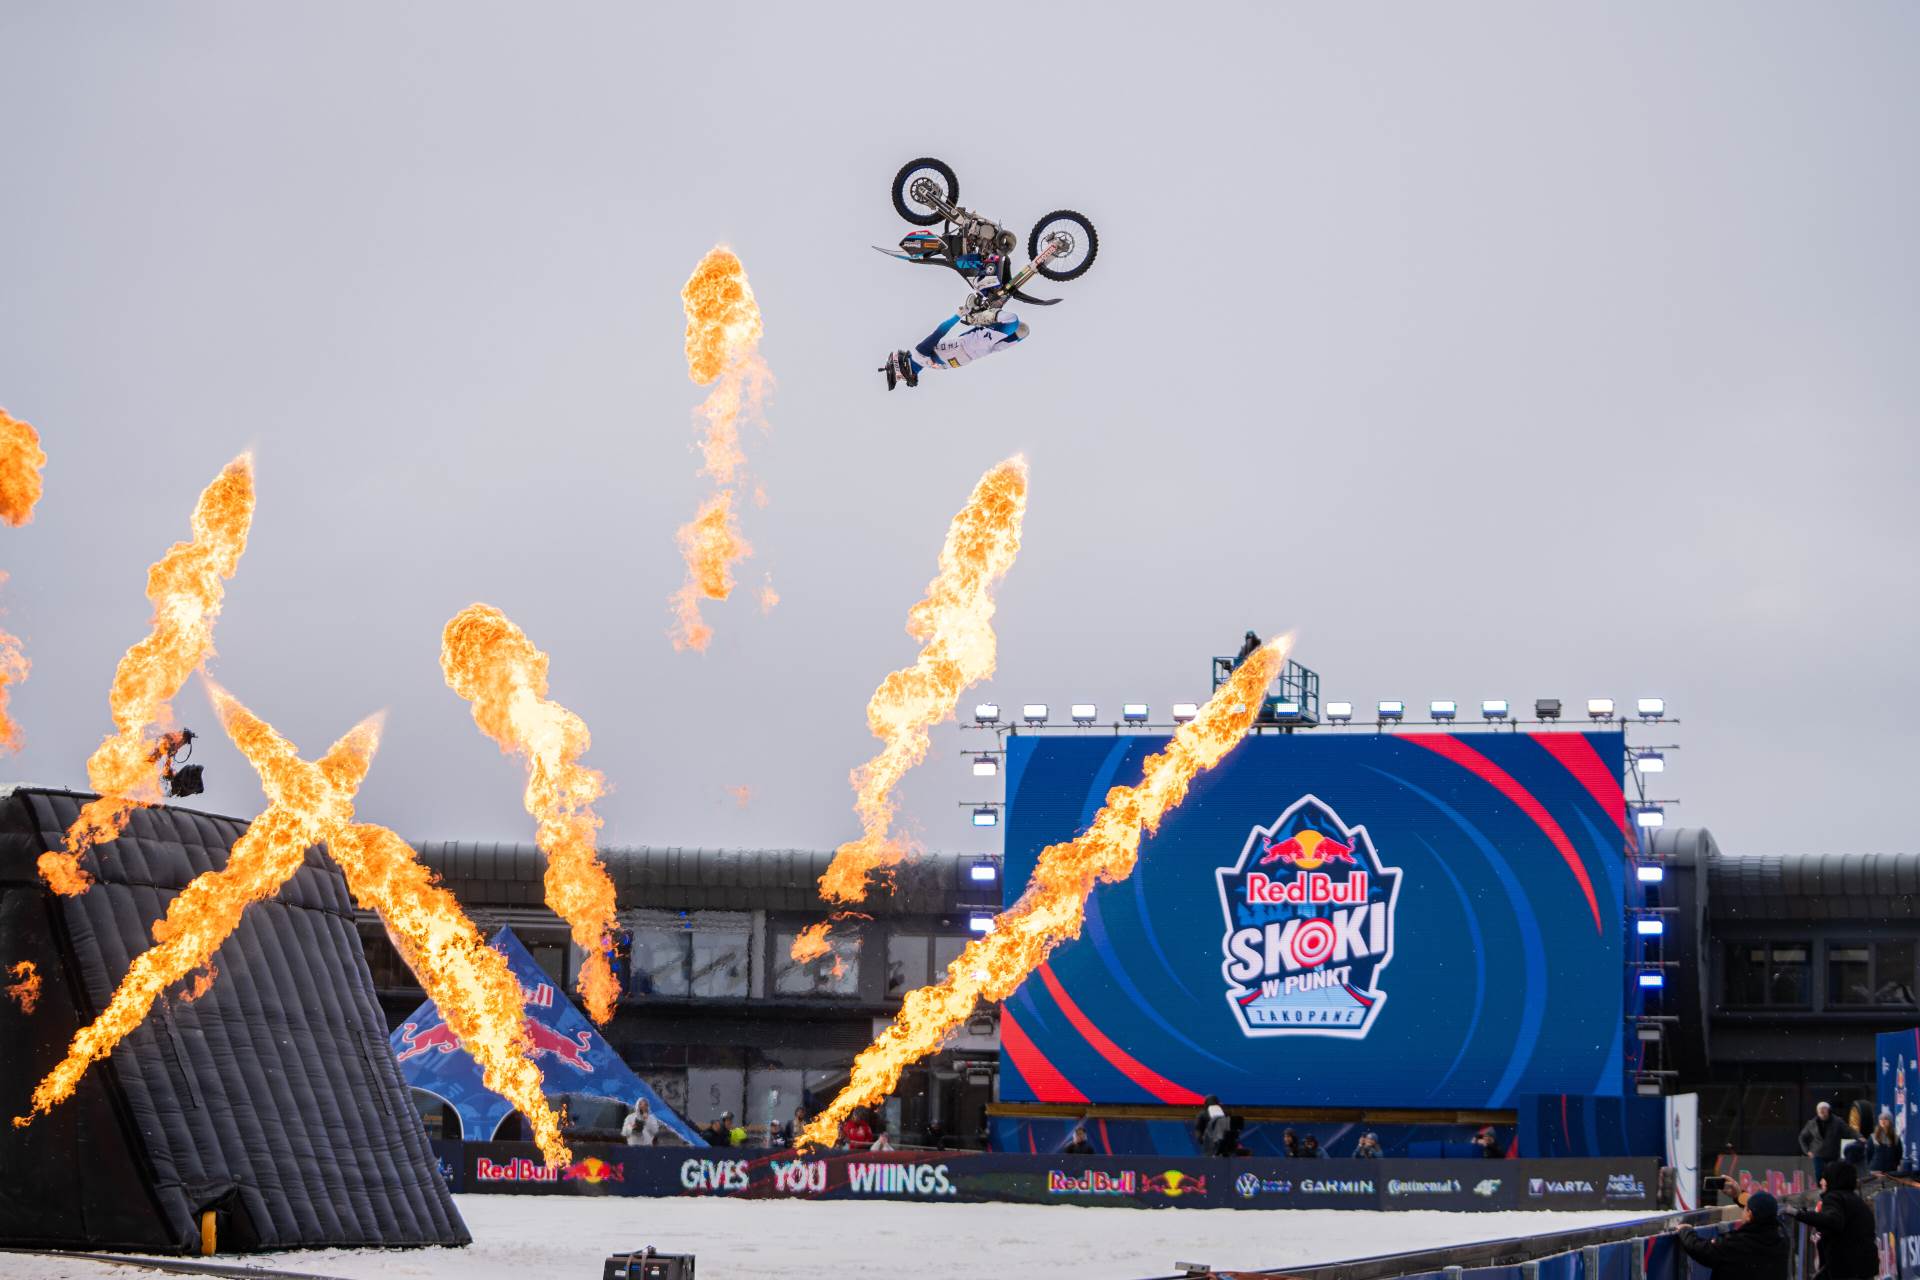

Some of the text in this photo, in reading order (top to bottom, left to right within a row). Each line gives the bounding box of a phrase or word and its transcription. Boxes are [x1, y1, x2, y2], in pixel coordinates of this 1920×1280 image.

[1247, 871, 1368, 903] Red Bull
[1230, 902, 1386, 981] SKOKI
[1262, 966, 1352, 998] W PUNKT
[1256, 1010, 1355, 1022] ZAKOPANE
[477, 1158, 517, 1181] Red
[680, 1159, 749, 1190] GIVES
[770, 1160, 826, 1192] YOU
[1049, 1170, 1135, 1195] Red Bull
[1300, 1179, 1376, 1194] GARMIN
[1546, 1181, 1594, 1192] VARTA
